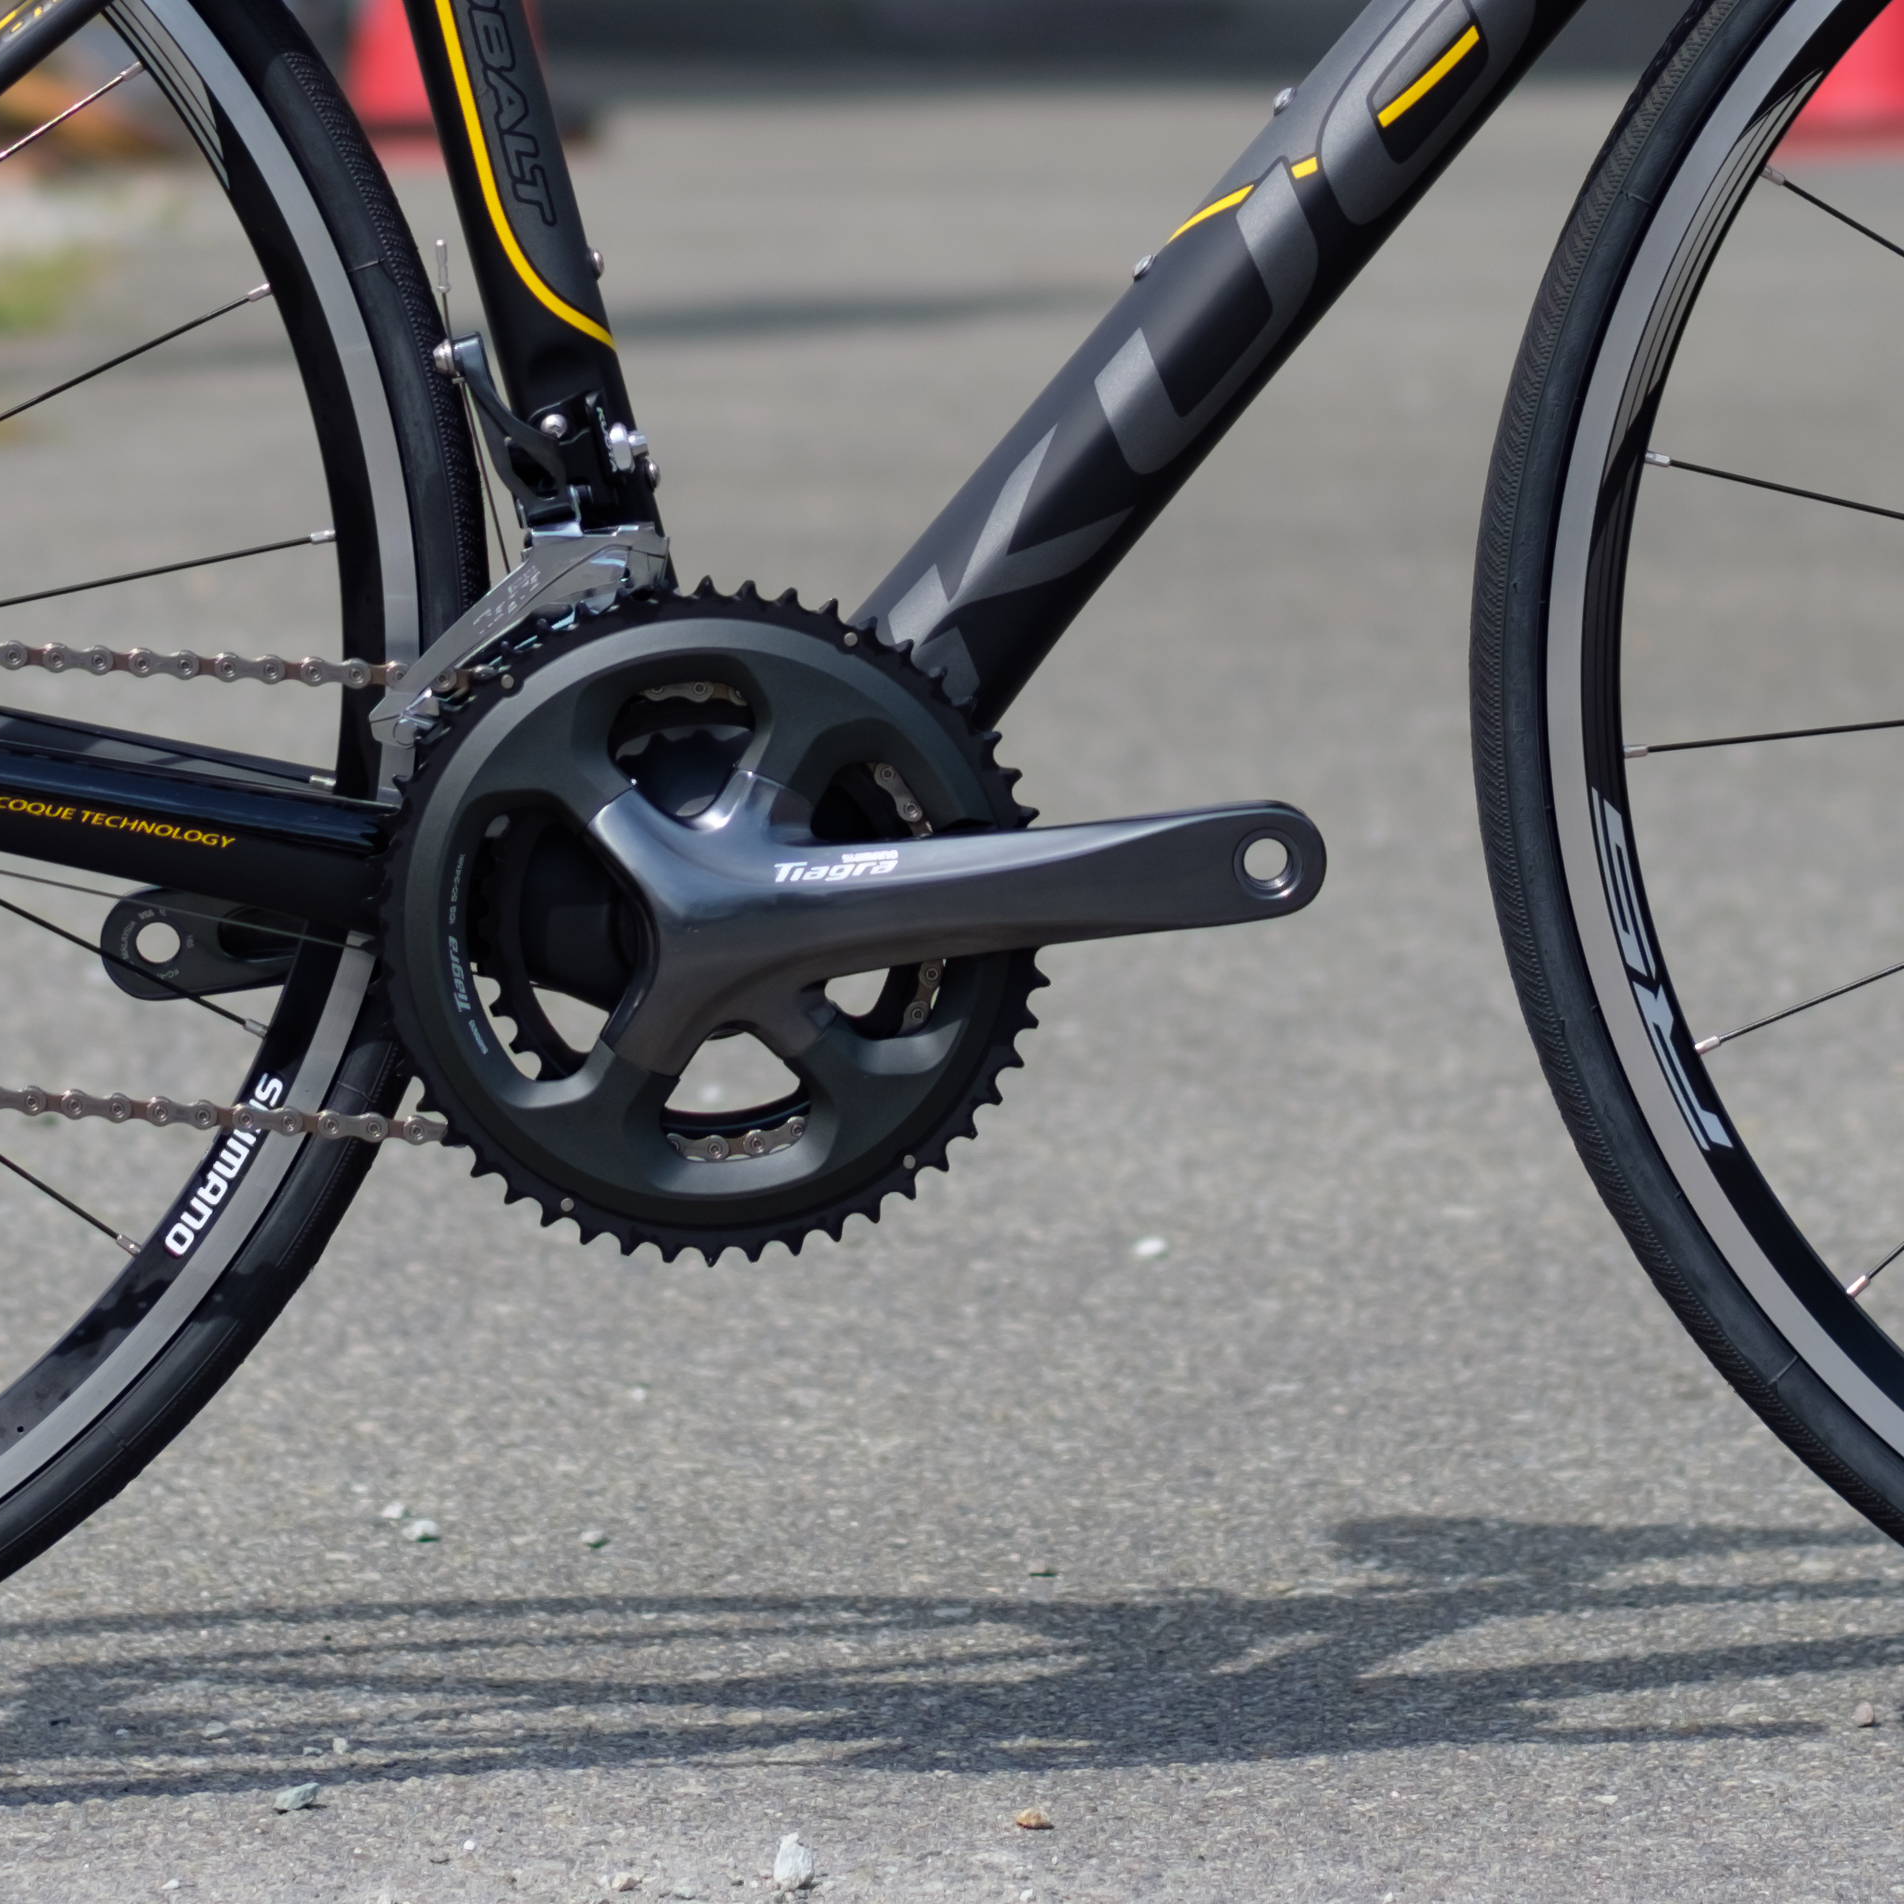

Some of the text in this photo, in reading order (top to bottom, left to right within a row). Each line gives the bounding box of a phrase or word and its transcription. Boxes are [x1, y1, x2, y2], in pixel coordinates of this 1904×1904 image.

[81, 809, 236, 850] TECHNOLOGY
[773, 860, 899, 884] Tiagra
[448, 935, 472, 1013] Tiagra
